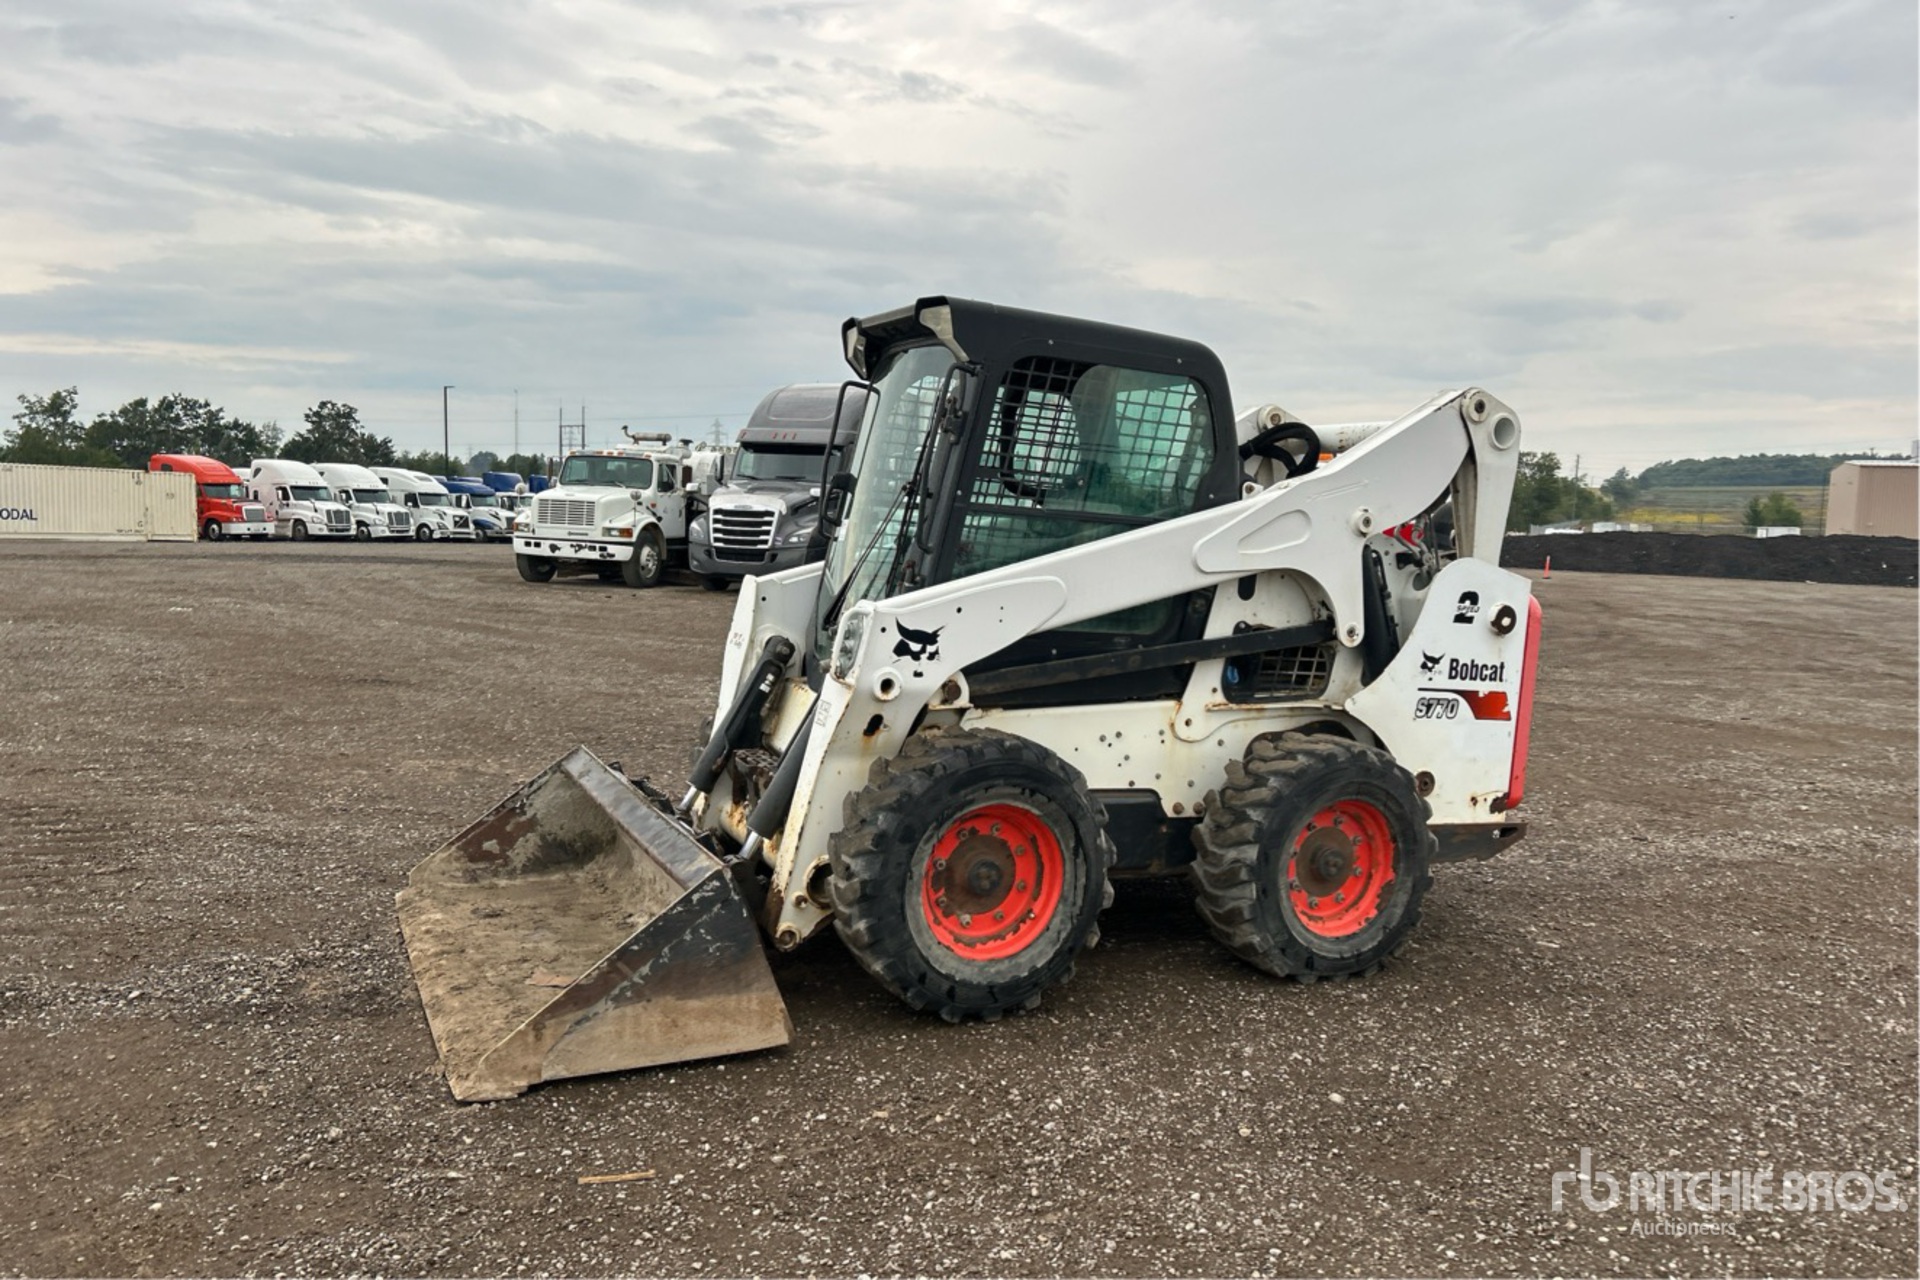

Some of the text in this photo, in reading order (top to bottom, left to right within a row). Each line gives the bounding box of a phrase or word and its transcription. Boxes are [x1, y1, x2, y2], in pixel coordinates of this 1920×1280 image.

[1453, 591, 1479, 624] 2
[1448, 658, 1505, 682] Bobcat
[1415, 697, 1459, 719] S770
